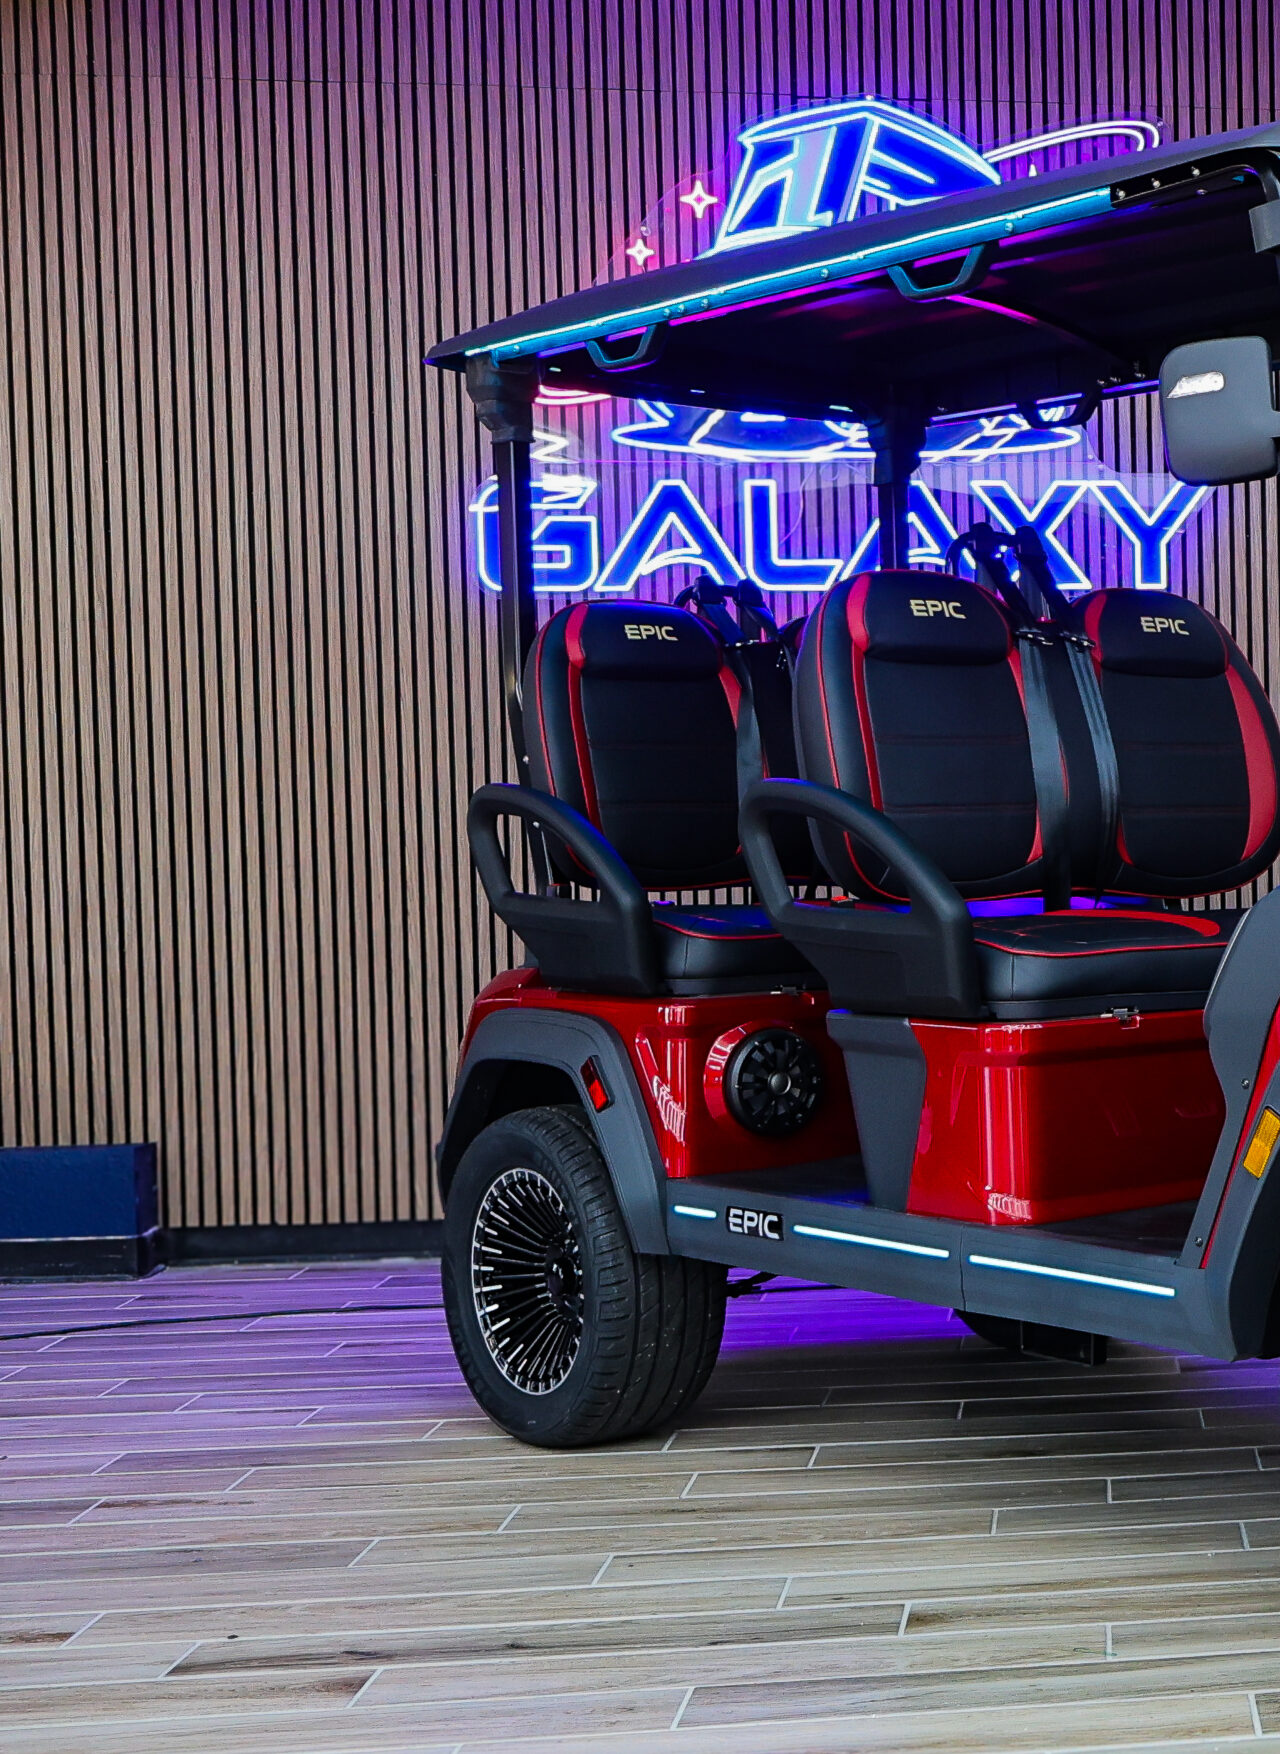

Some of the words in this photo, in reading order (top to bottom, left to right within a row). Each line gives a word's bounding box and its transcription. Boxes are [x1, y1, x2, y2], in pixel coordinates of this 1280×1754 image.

[475, 478, 1209, 592] GALAXY
[909, 599, 967, 619] EPIC
[624, 624, 678, 641] EPIC
[1140, 616, 1190, 635] EPIC
[728, 1207, 780, 1240] EPIC
